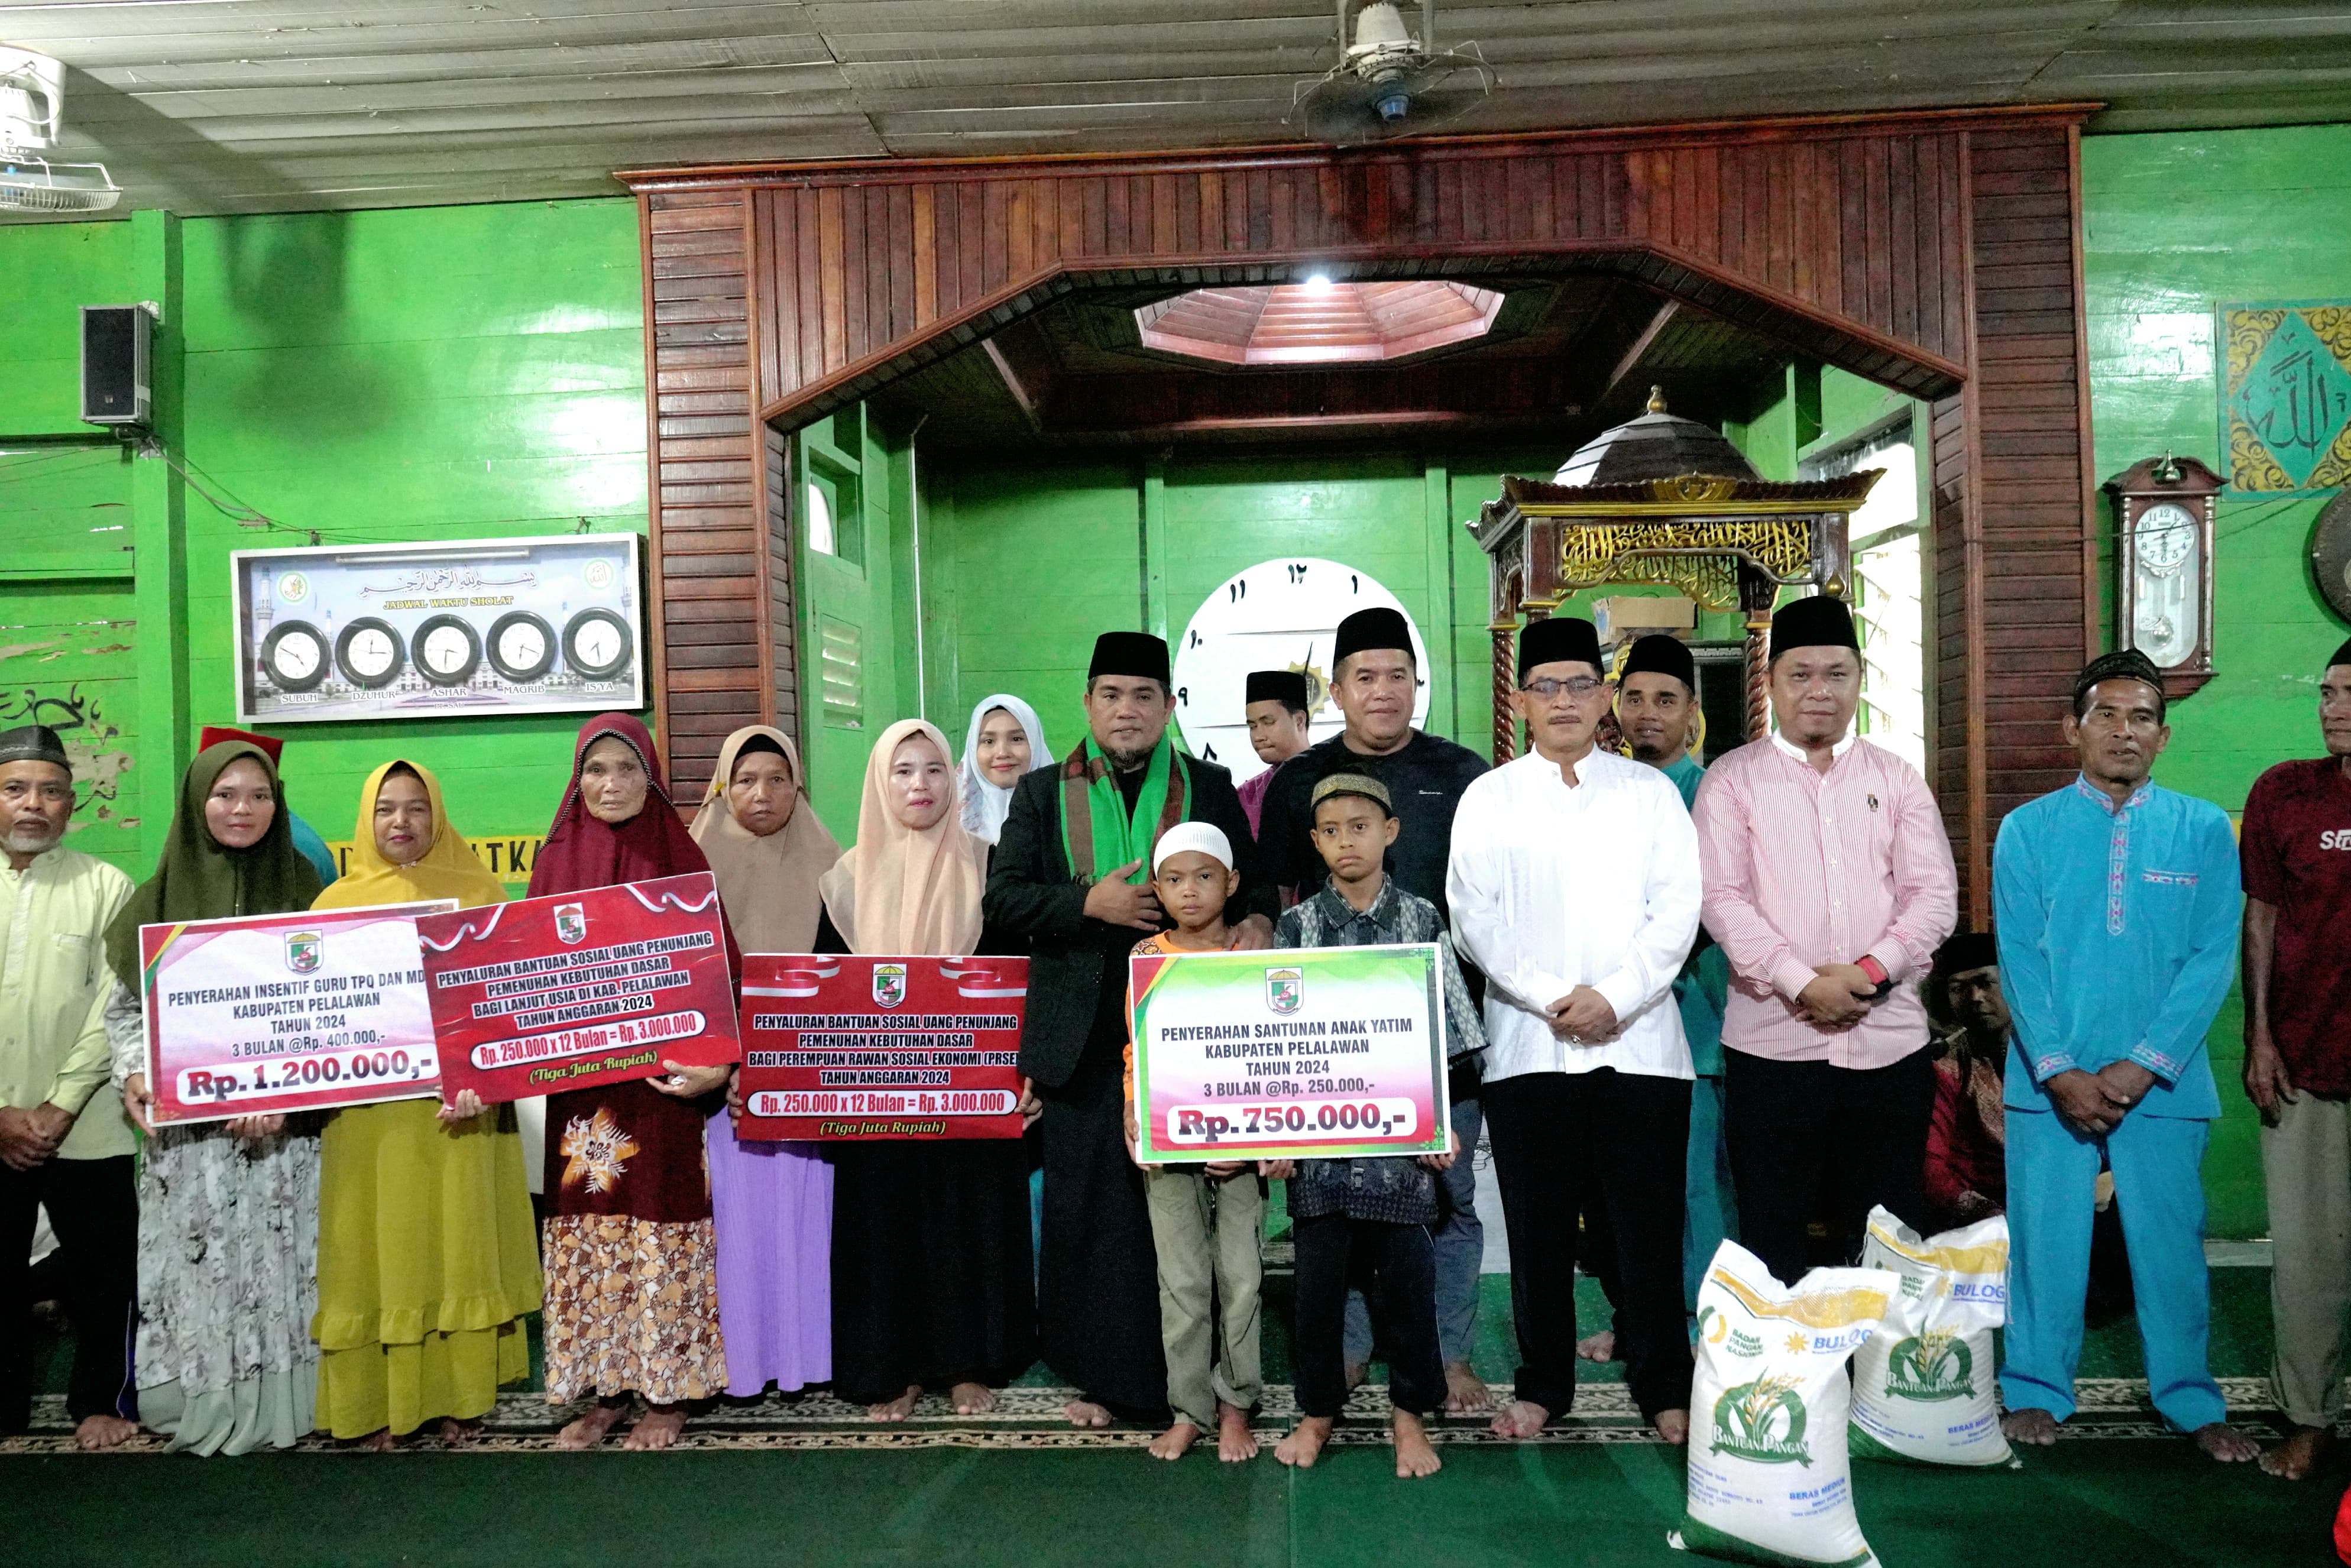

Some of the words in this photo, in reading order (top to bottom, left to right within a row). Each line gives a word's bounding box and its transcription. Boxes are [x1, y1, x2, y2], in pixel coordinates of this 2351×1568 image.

[383, 601, 428, 610] JADWAL
[430, 598, 468, 608] WAKTU
[470, 595, 514, 607] SHOLAT
[282, 694, 318, 703] SUBUH
[352, 691, 396, 700] DZUHUR
[432, 688, 467, 697] ASHAR
[438, 966, 511, 987] PENYALURAN
[514, 956, 568, 974] BANTUAN
[571, 950, 610, 966] SOSIAL
[613, 944, 645, 958] UANG
[647, 932, 713, 954] PENUNJANG
[488, 977, 558, 997] PEMENUHAN
[561, 966, 629, 984] KEBUTUHAN
[632, 958, 670, 974] DASAR
[169, 986, 251, 1006] PENYERAHAN
[255, 980, 310, 999] INSENTIF
[314, 977, 347, 993] GURU
[351, 974, 375, 990] TPQ
[378, 972, 403, 986] DAN
[474, 1002, 502, 1017] BAGI
[504, 994, 546, 1012] LANJUT
[549, 990, 576, 1005] USIA
[579, 987, 592, 1000] DI
[593, 983, 620, 998] KAB.
[623, 971, 689, 993] PELALAWAN
[234, 999, 304, 1020] KABUPATEN
[309, 992, 380, 1013] PELALAWAN
[516, 1012, 555, 1029] TAHUN
[558, 1001, 620, 1022] ANGGARAN
[622, 996, 652, 1011] 2024
[271, 1018, 311, 1034] TAHUN
[316, 1015, 345, 1030] 2024
[754, 1016, 825, 1029] PENYALURAN
[828, 1016, 879, 1029] BANTUAN
[882, 1016, 921, 1029] SOSIAL
[922, 1016, 953, 1029] UANG
[956, 1016, 1017, 1030] PENUNJANG
[1161, 1023, 1249, 1042] PENYERAHAN
[1254, 1022, 1326, 1039] SANTUNAN
[1331, 1019, 1367, 1035] ANAK
[1370, 1018, 1412, 1034] YATIM
[232, 1043, 239, 1057] 3
[244, 1038, 284, 1056] BULAN
[289, 1035, 323, 1054] @Rp.
[327, 1030, 386, 1047] 400.000,-
[480, 1047, 498, 1066] Rp.
[501, 1038, 548, 1059] 250.000
[550, 1042, 557, 1052] x
[559, 1035, 572, 1051] 12
[575, 1026, 608, 1048] Bulan
[620, 1023, 638, 1044] Rp.
[640, 1014, 697, 1038] 3.000.000
[798, 1034, 866, 1047] PEMENUHAN
[869, 1034, 934, 1047] KEBUTUHAN
[937, 1034, 973, 1047] DASAR
[1205, 1041, 1283, 1058] KABUPATEN
[1288, 1039, 1369, 1056] PELALAWAN
[529, 1064, 566, 1084] (Tiga
[570, 1061, 601, 1081] Juta
[604, 1050, 658, 1073] Rupiah)
[749, 1052, 776, 1066] BAGI
[779, 1052, 846, 1066] PEREMPUAN
[849, 1052, 888, 1066] RAWAN
[890, 1052, 930, 1065] SOSIAL
[932, 1052, 982, 1066] EKONOMI
[1246, 1062, 1291, 1077] TAHUN
[1295, 1060, 1330, 1075] 2024
[820, 1071, 857, 1084] TAHUN
[859, 1071, 919, 1084] ANGGARAN
[921, 1071, 950, 1084] 2024
[1204, 1083, 1212, 1097] 3
[1216, 1082, 1261, 1096] BULAN
[1265, 1081, 1303, 1097] @Rp.
[1309, 1078, 1375, 1093] 250.000,-
[761, 1094, 781, 1114] Rp.
[784, 1094, 837, 1112] 250.000
[840, 1099, 847, 1112] x
[851, 1094, 864, 1112] 12
[867, 1093, 904, 1112] Bulan
[918, 1094, 938, 1113] Rp.
[941, 1093, 1005, 1112] 3.000.000
[820, 1121, 856, 1136] (Tiga
[859, 1122, 889, 1136] Juta
[893, 1121, 946, 1136] Rupiah)
[1954, 1284, 2005, 1298] BULOG
[1712, 1423, 1760, 1451] BANTUAN
[1762, 1433, 1809, 1454] PANGAN
[1789, 1490, 1819, 1500] BERAS
